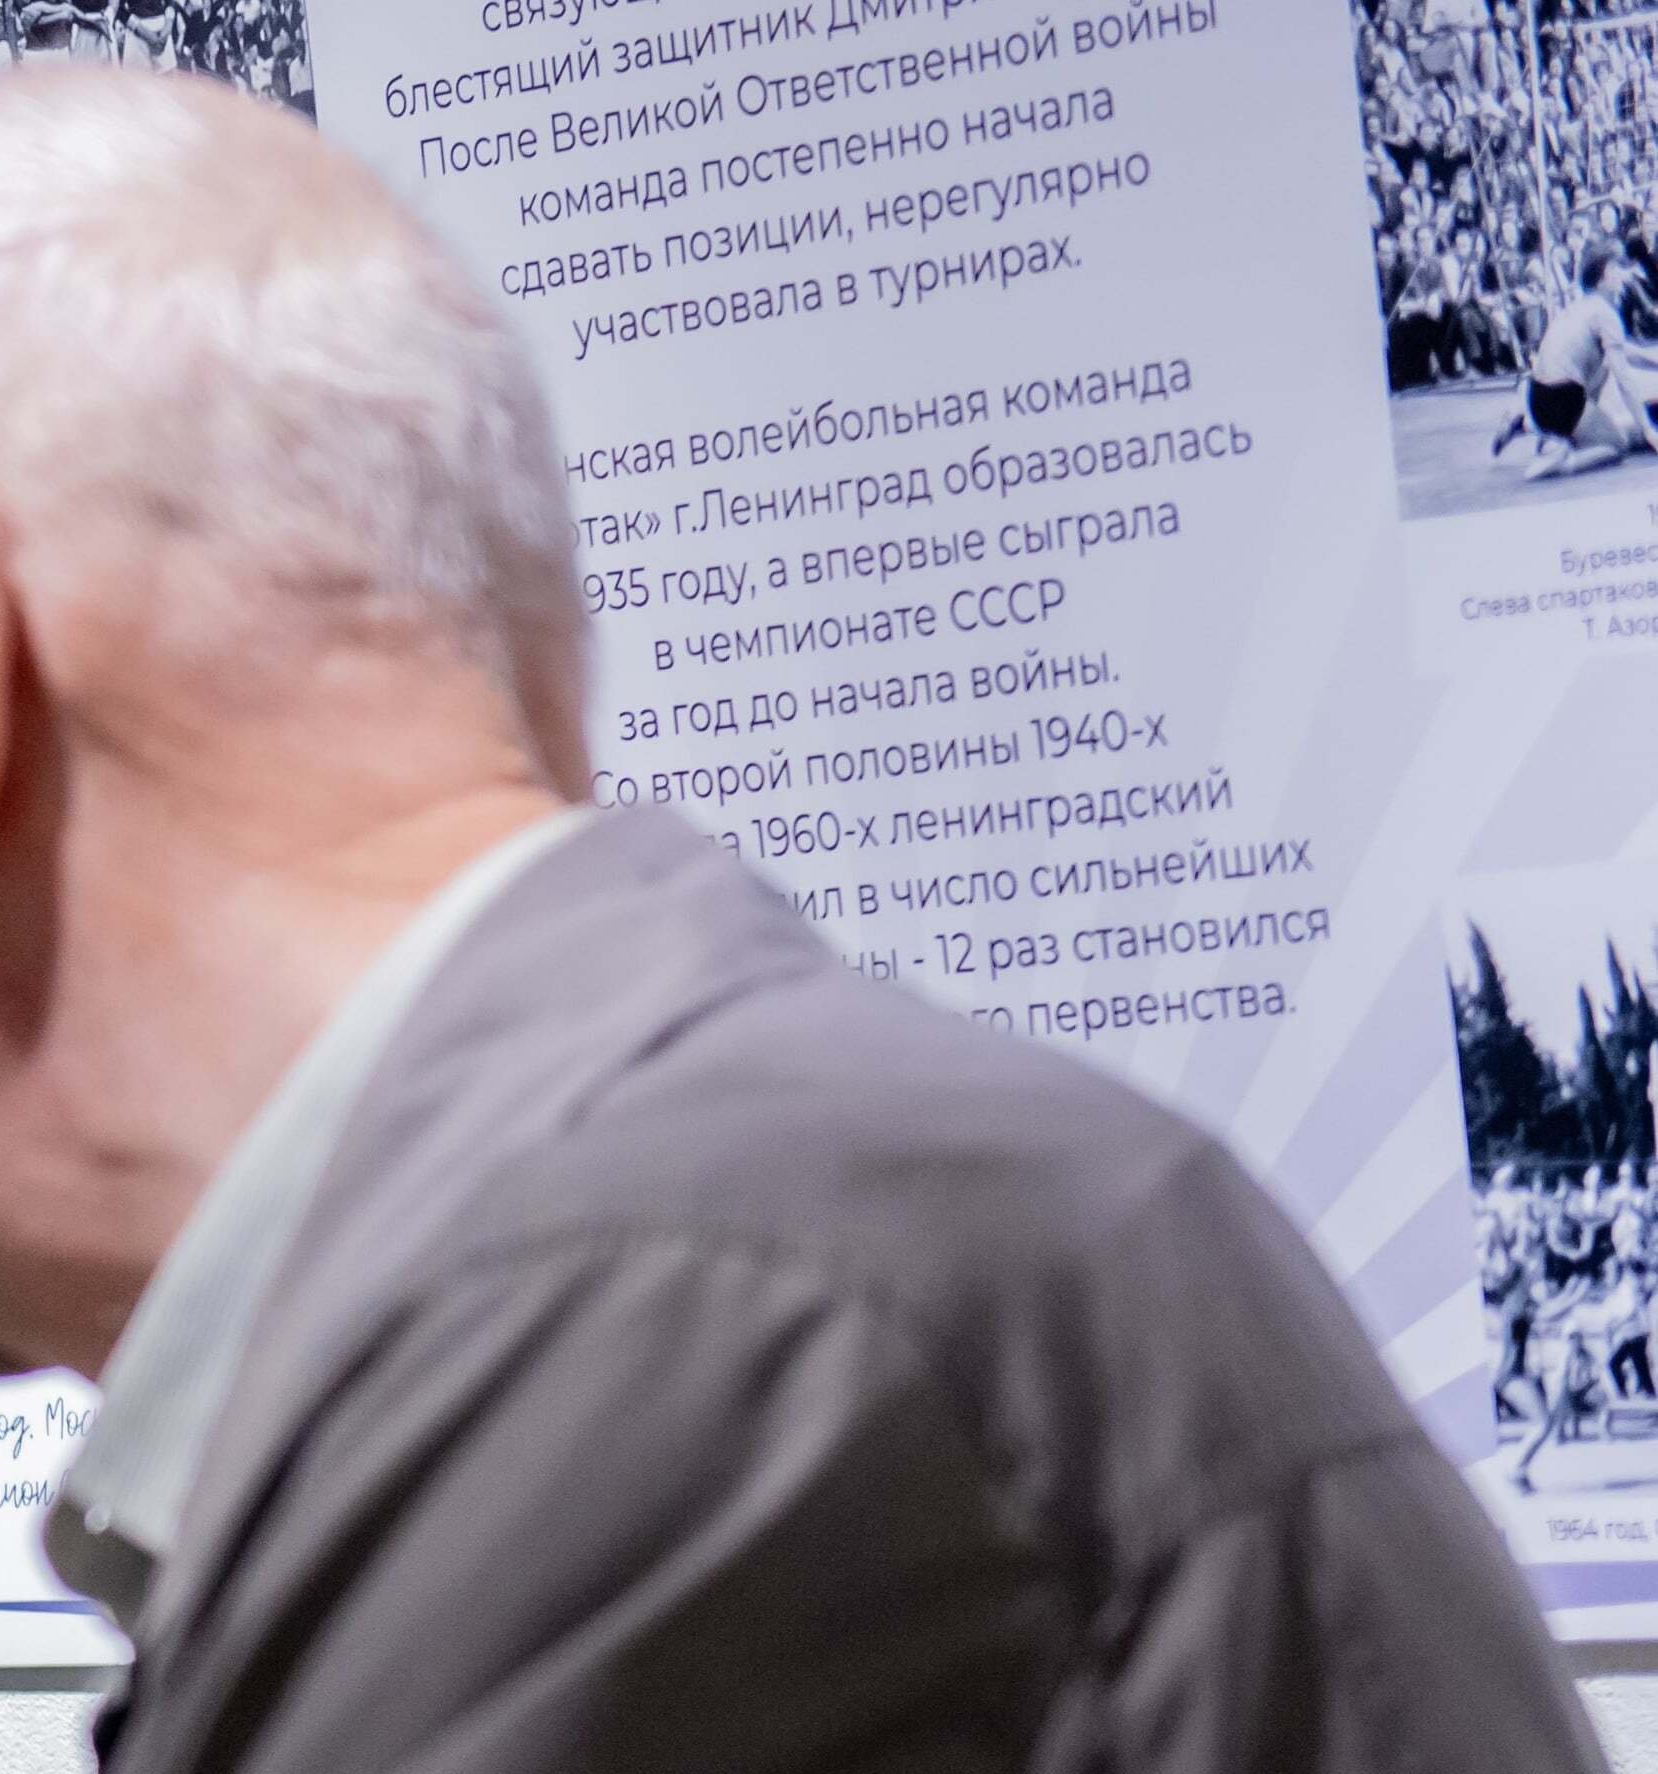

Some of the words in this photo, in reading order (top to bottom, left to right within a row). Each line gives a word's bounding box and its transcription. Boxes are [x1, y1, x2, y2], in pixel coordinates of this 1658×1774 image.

[385, 36, 601, 119] блестящий
[611, 3, 817, 75] защитник
[419, 127, 538, 179] После
[550, 79, 724, 154] Великой
[736, 15, 1058, 117] Ответственной
[1072, 0, 1217, 55] войны
[519, 166, 688, 227] команда
[701, 117, 950, 194] постепенно
[962, 86, 1115, 146] начала
[501, 242, 653, 301] сдавать
[664, 205, 854, 268] позиции,
[865, 151, 1151, 235] нерегулярно
[571, 278, 823, 362] участвовала
[836, 272, 859, 307] в
[867, 235, 1083, 309] турнирах.
[563, 437, 676, 487] нская
[688, 388, 989, 467] волейбольная
[1002, 358, 1193, 418] команда
[674, 467, 934, 536] г.Ленинград
[943, 422, 1253, 499] образовалась
[582, 565, 650, 615] 935
[661, 561, 756, 606] году,
[767, 556, 789, 589] а
[801, 528, 986, 585] впервые
[998, 501, 1181, 558] сыграла
[1460, 594, 1531, 620] Слева
[654, 639, 675, 672] в
[684, 603, 937, 666] чемпионате
[949, 577, 1066, 633] СССР
[618, 708, 660, 742] за
[672, 697, 740, 738] год
[748, 690, 798, 734] до
[810, 670, 957, 719] начала
[970, 648, 1120, 700] войны.
[591, 769, 640, 810] Со
[651, 747, 792, 808] второй
[805, 731, 1020, 787] половины
[1029, 709, 1168, 761] 1940-х
[750, 810, 880, 859] 1960-х
[889, 767, 1233, 846] ленинградский
[792, 885, 845, 922] ил
[857, 883, 880, 916] в
[890, 869, 1019, 911] число
[1029, 838, 1313, 898] сильнейших
[933, 931, 977, 975] 12
[987, 933, 1061, 982] раз
[1072, 907, 1331, 963] становился
[1027, 982, 1297, 1041] первенства.
[45, 1395, 100, 1440] Мос
